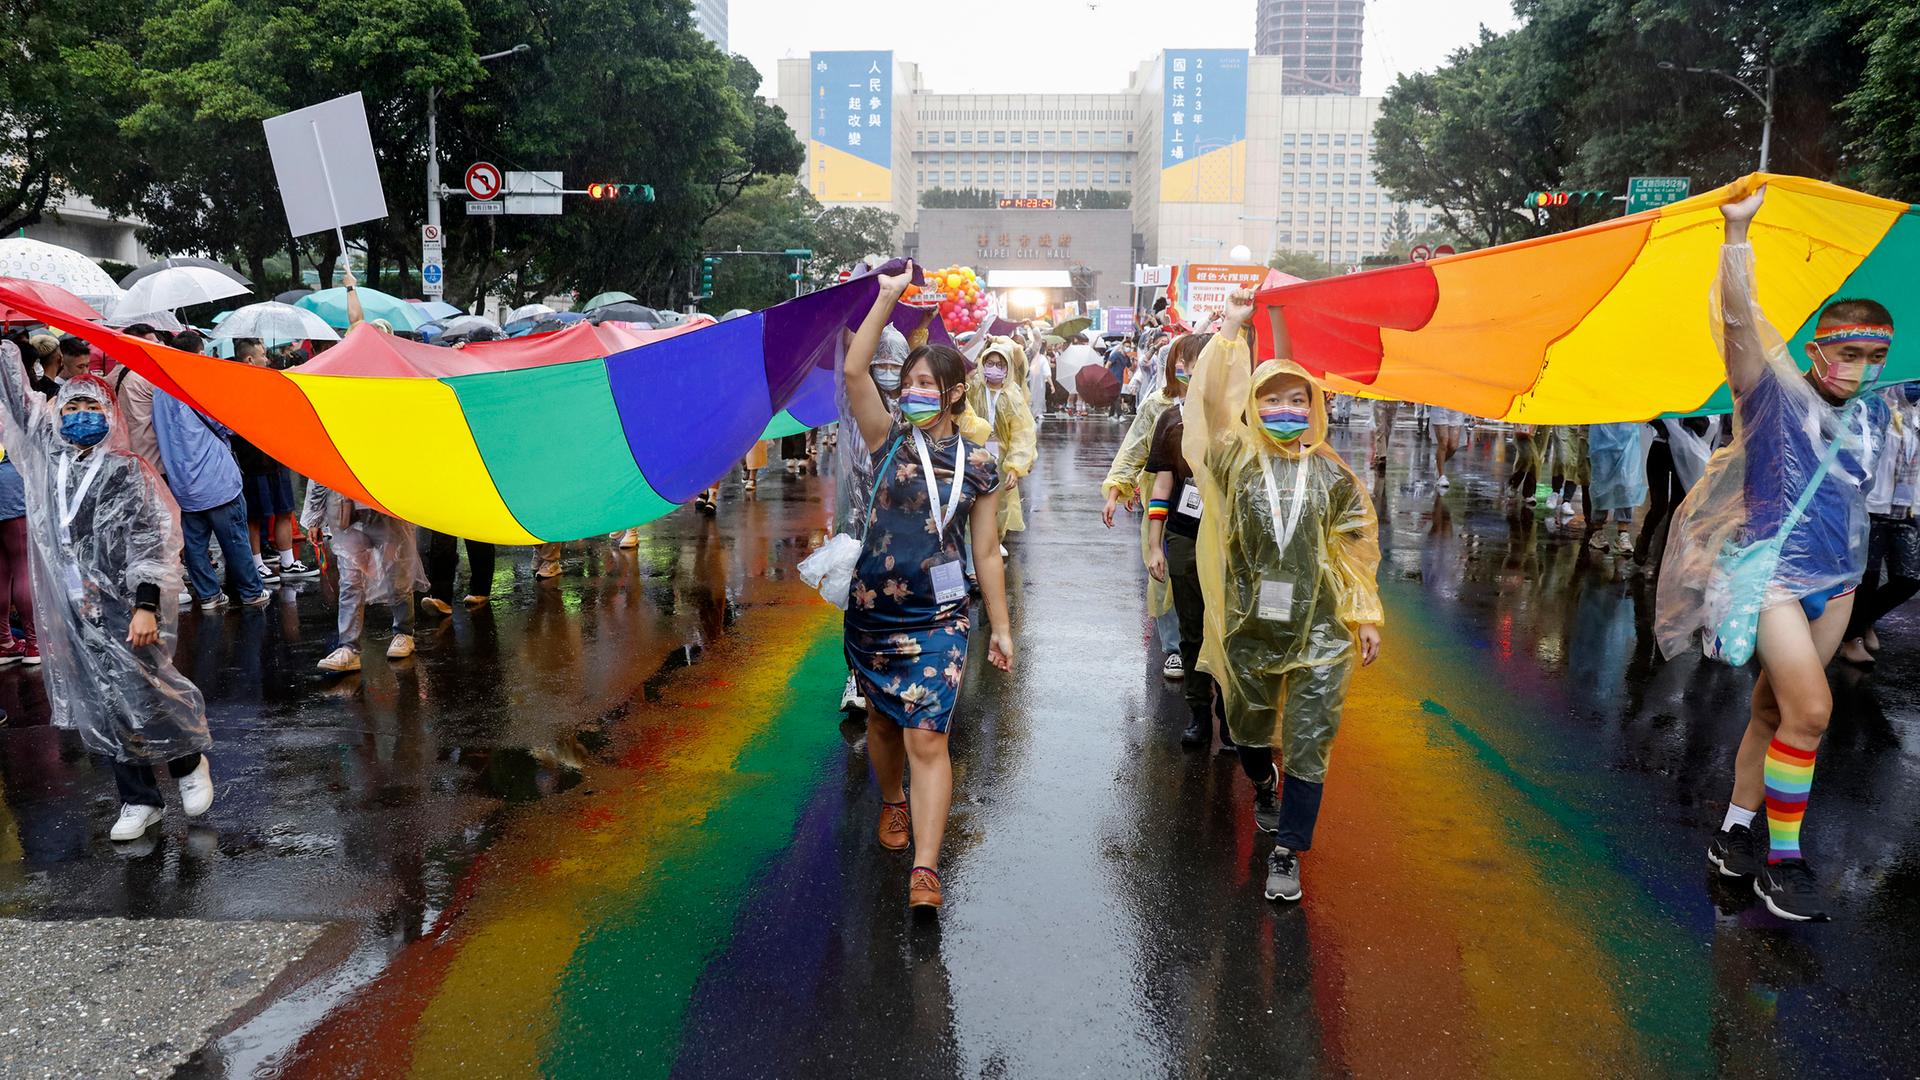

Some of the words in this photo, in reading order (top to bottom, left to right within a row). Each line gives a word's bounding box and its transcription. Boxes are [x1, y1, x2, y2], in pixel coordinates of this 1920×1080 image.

[848, 83, 862, 145] 一起改變
[868, 60, 882, 127] 人民參與
[1171, 58, 1186, 159] 國民法官上場
[1193, 58, 1203, 124] 2023年
[1015, 199, 1053, 208] 14:23:24
[978, 249, 1010, 258] TAIPEI
[1017, 249, 1040, 258] CITY
[1047, 249, 1071, 258] HALL
